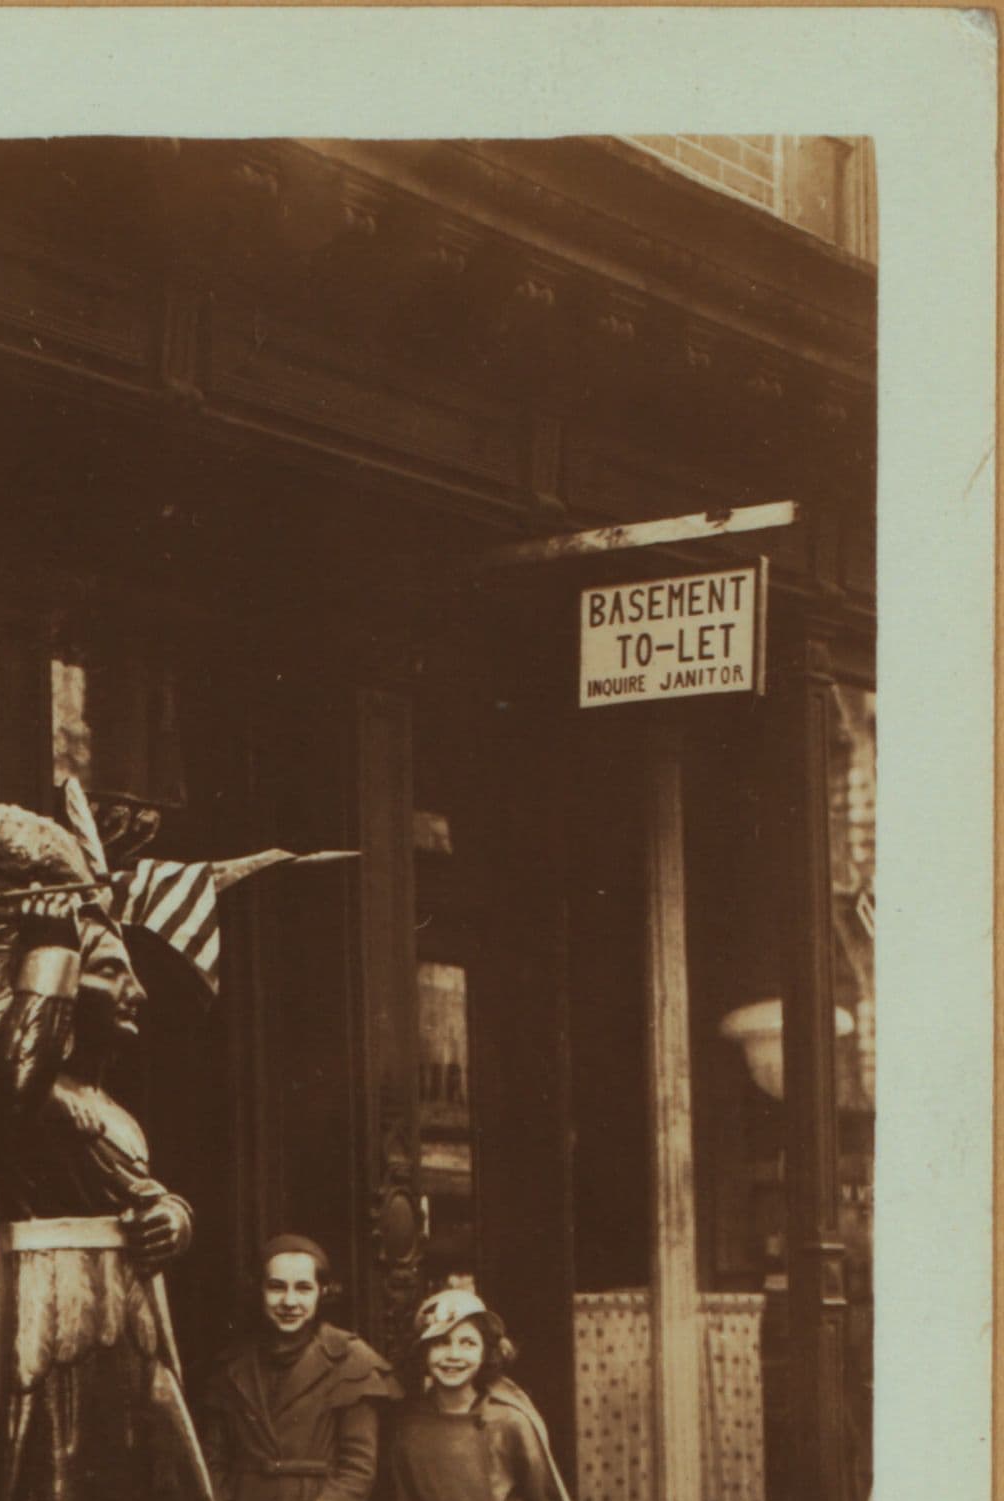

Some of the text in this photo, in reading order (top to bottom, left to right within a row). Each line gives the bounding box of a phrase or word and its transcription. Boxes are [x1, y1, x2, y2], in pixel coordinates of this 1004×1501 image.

[589, 576, 746, 628] BASEMENT
[617, 623, 736, 669] TO-LET
[587, 664, 744, 698] INQUIRE JANITOR
